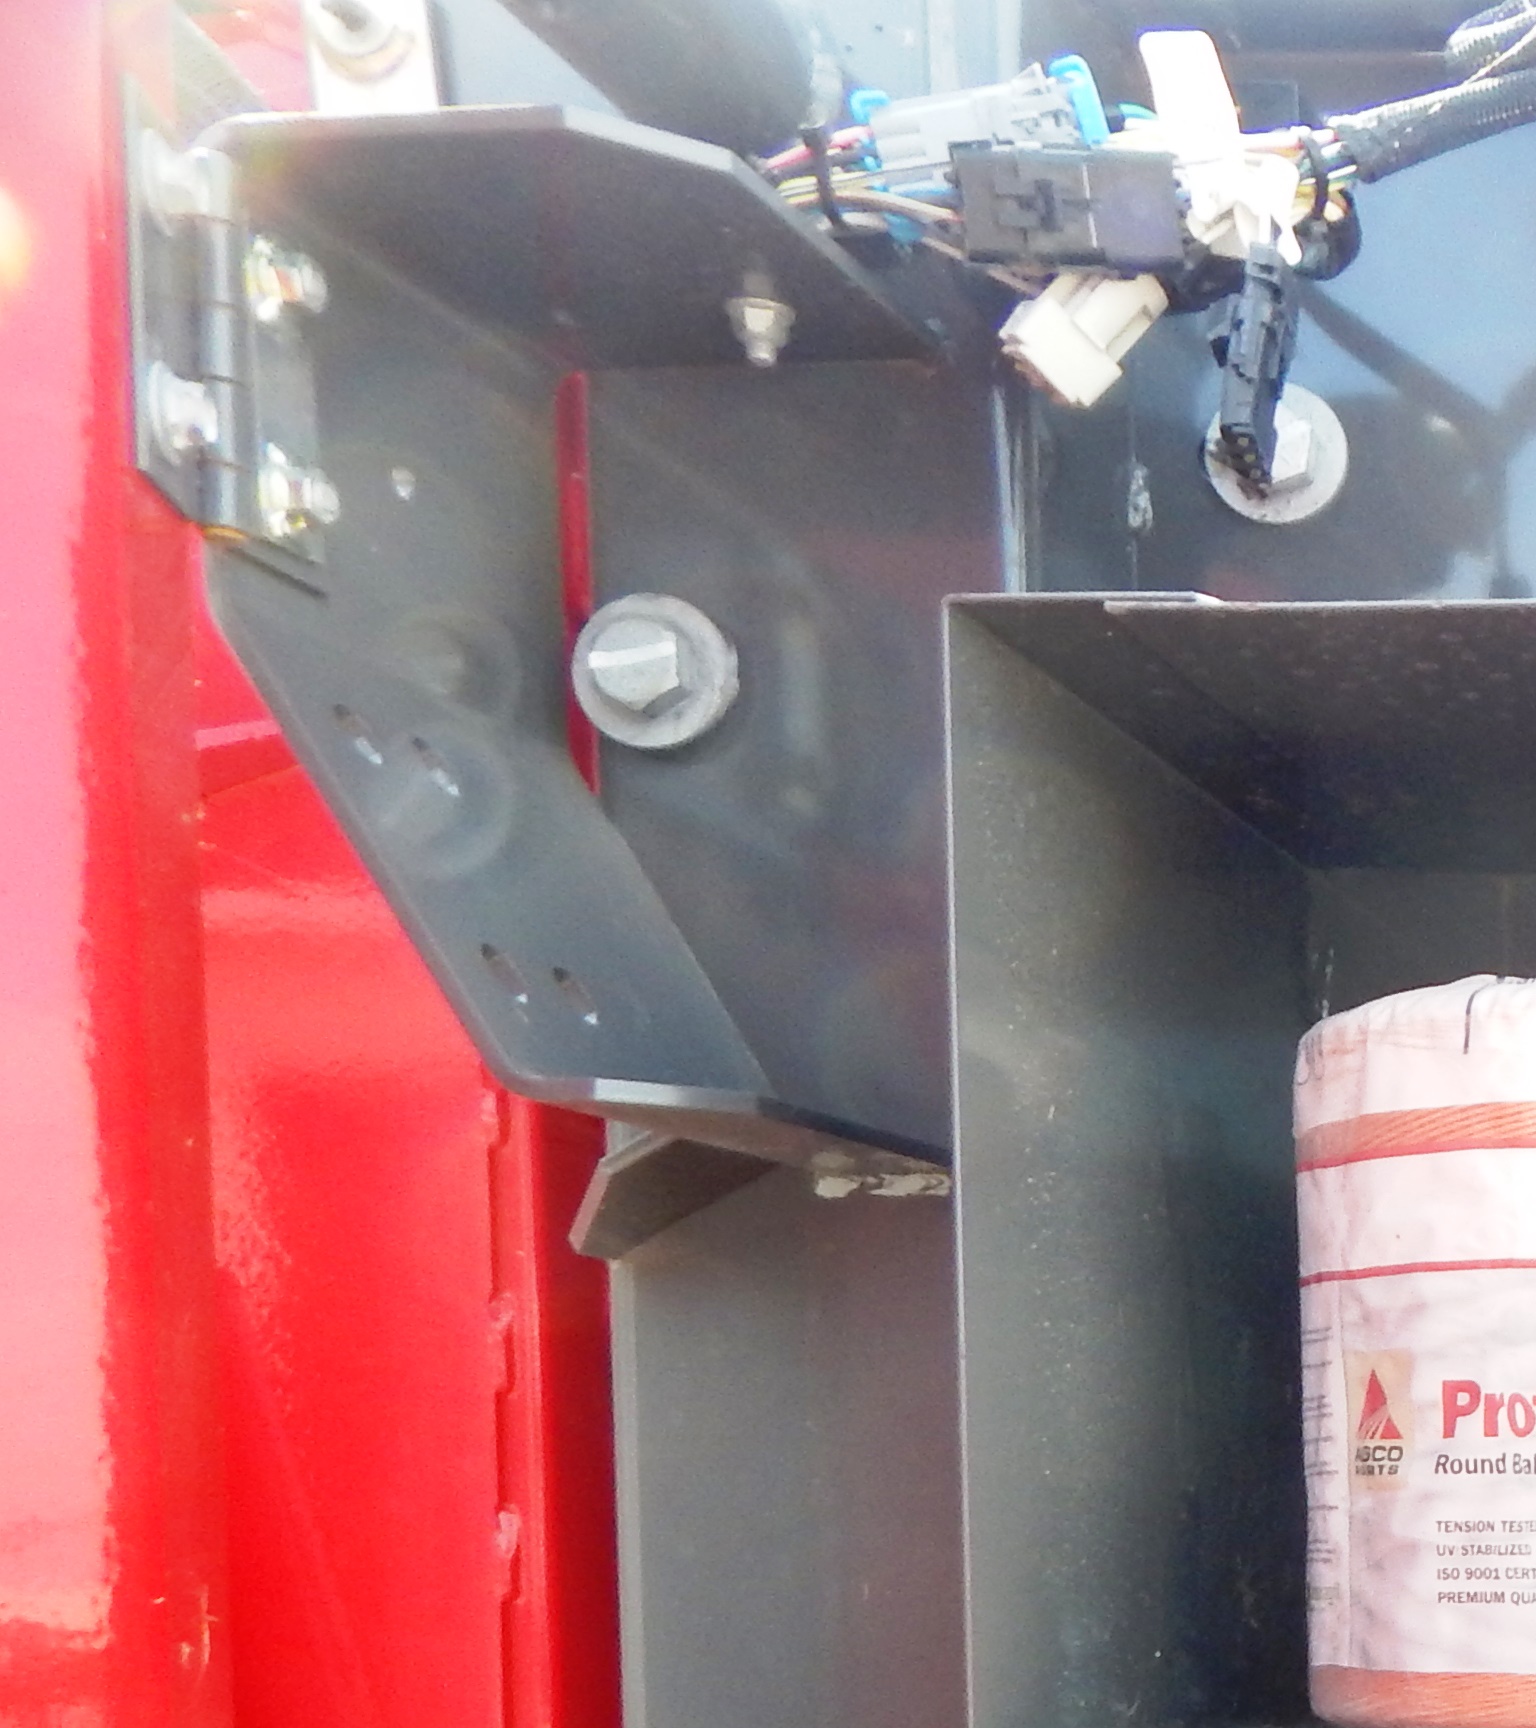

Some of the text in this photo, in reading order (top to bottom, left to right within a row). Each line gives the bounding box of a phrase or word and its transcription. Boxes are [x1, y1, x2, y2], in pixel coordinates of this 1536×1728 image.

[1434, 1454, 1507, 1475] Round
[1436, 1520, 1495, 1533] TENSION
[1436, 1544, 1455, 1557] UV
[1437, 1567, 1460, 1581] ISO
[1465, 1567, 1501, 1581] 9001
[1437, 1591, 1506, 1604] PREMIUM
